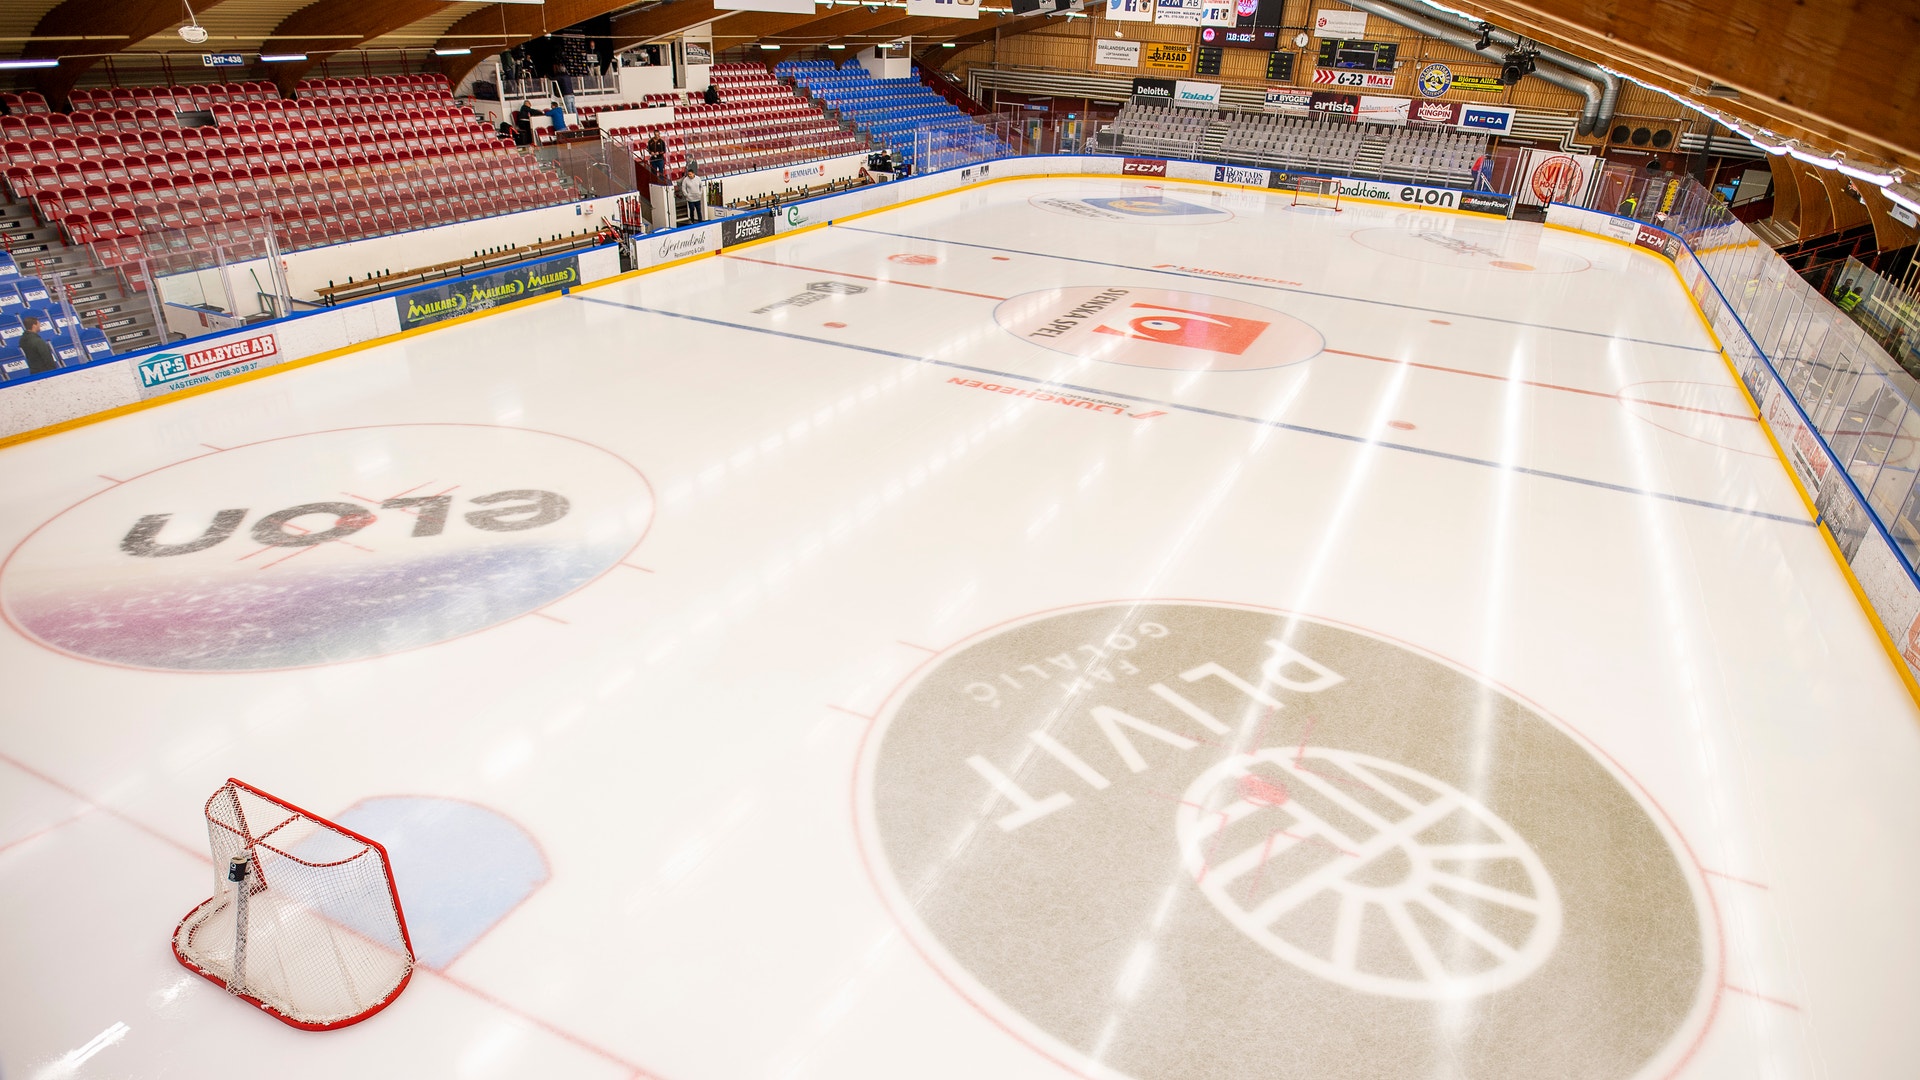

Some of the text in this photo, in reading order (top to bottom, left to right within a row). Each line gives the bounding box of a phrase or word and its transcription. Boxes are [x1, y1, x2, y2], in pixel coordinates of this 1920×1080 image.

[204, 56, 211, 64] B
[1162, 53, 1187, 62] FASAD
[1338, 73, 1363, 85] 6-23
[1367, 75, 1393, 85] MAXI
[1181, 92, 1214, 101] Talab
[1314, 101, 1354, 113] artista
[1419, 109, 1452, 118] KINGPIN
[1124, 163, 1165, 173] CCM
[736, 217, 762, 231] HOCKEY
[741, 226, 761, 237] STORE
[1637, 232, 1664, 248] CCM
[1029, 288, 1129, 338] SVENSKA SPEL
[189, 343, 249, 368] ALLBYGG
[252, 335, 275, 355] AB
[947, 377, 1125, 415] LJUNGHEDEN
[965, 639, 1346, 832] PLIVIT
